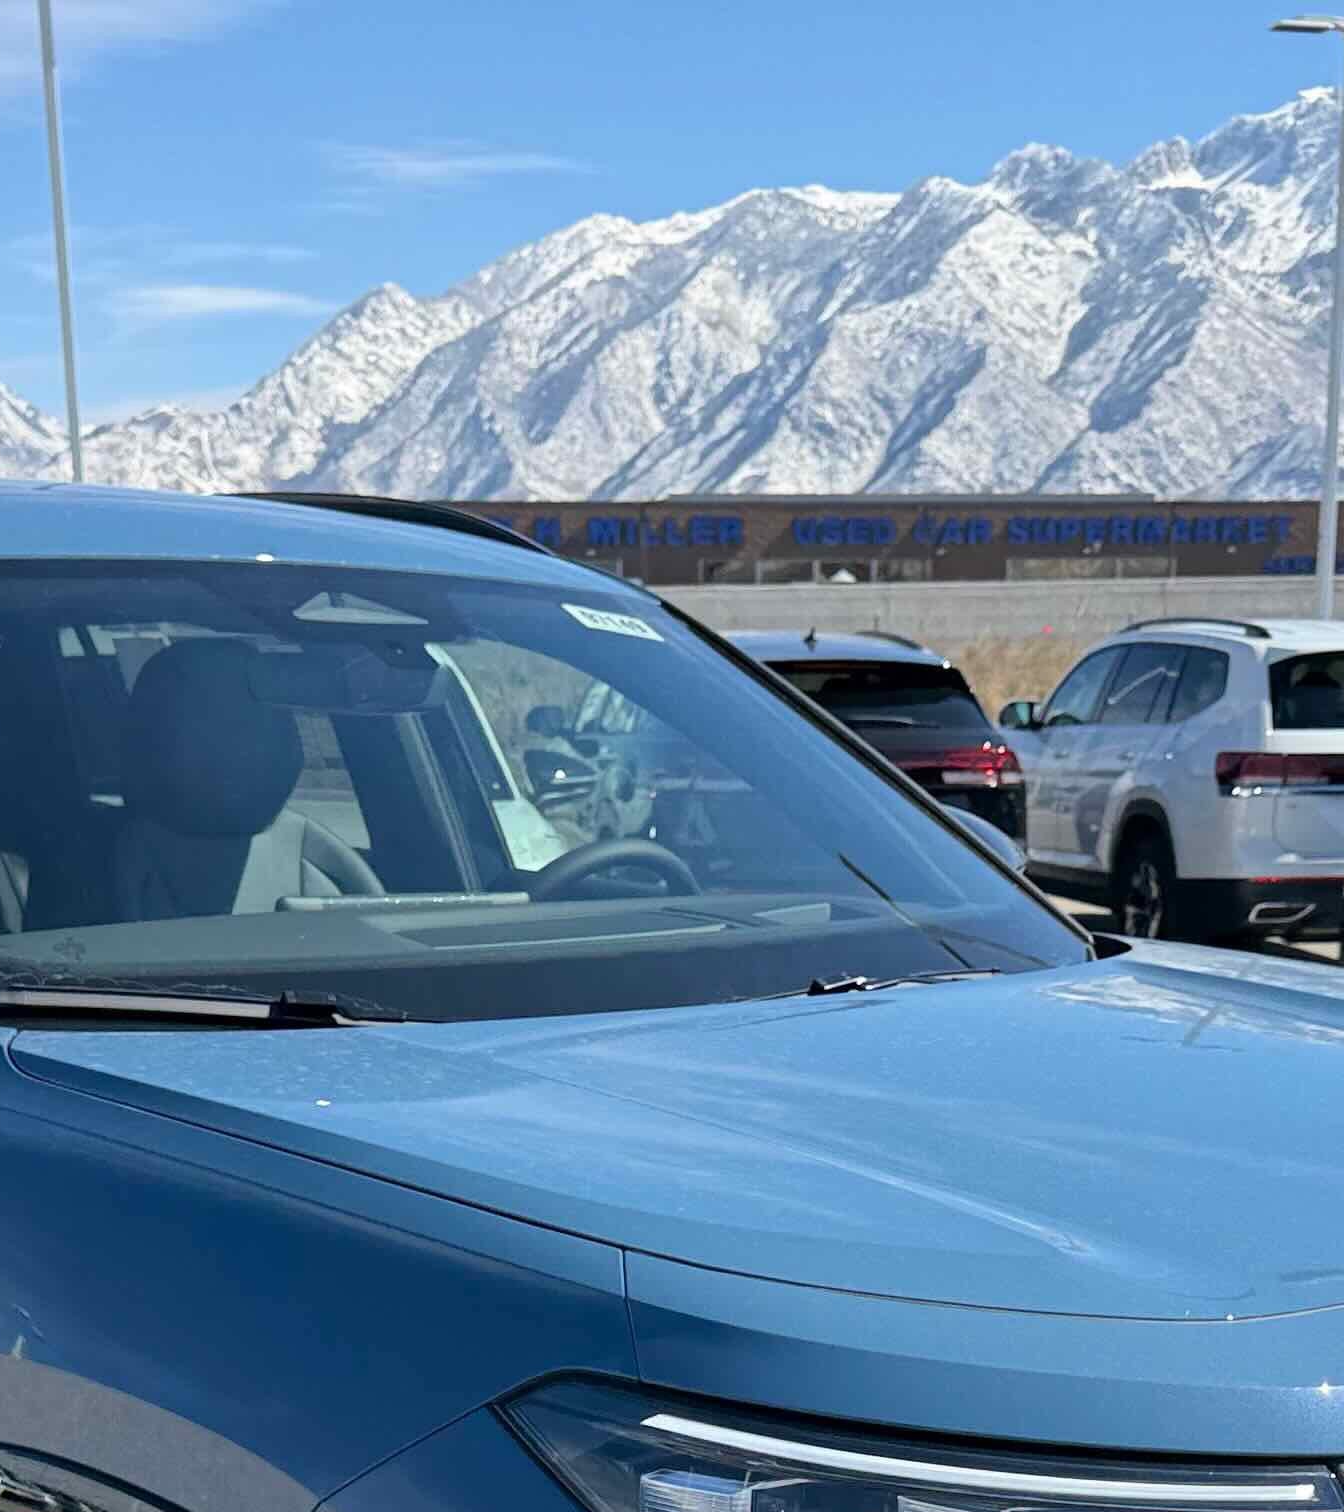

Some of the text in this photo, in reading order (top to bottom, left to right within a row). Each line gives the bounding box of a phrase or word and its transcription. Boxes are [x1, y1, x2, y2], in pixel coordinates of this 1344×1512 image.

[587, 516, 743, 545] MILLER
[791, 516, 897, 545] USED
[912, 513, 993, 545] CAR
[1007, 515, 1293, 545] SUPERMARKET
